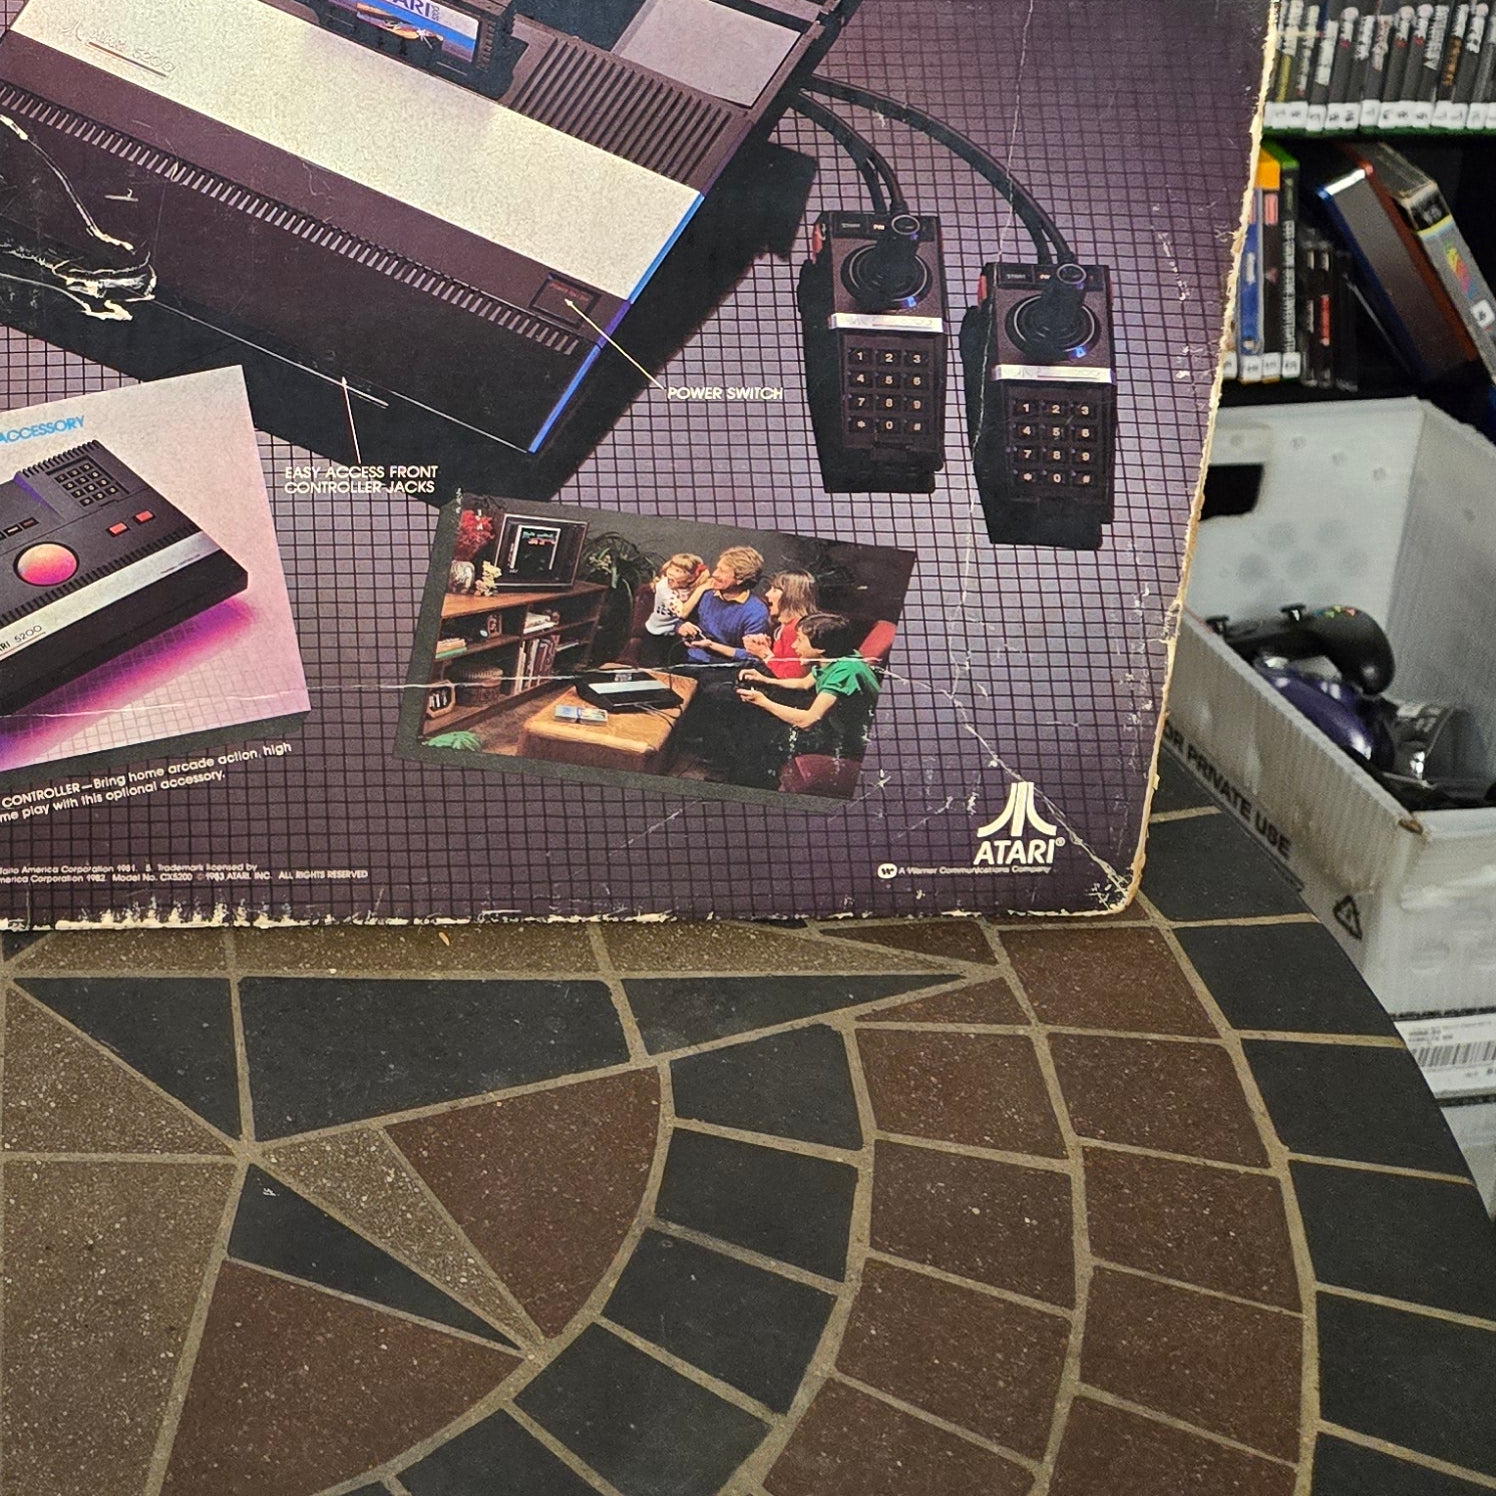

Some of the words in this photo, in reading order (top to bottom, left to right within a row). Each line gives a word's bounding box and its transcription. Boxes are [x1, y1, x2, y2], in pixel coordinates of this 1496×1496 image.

[667, 387, 722, 400] POWER
[727, 387, 783, 399] SWITCH
[285, 466, 319, 480] EASY
[325, 466, 385, 480] ACCESS
[389, 465, 438, 479] FRONT
[284, 481, 381, 494] CONTROLLER
[385, 480, 435, 494] JACKS
[14, 624, 43, 644] 5200
[1186, 749, 1252, 824] PRIVATE
[1254, 811, 1292, 859] USE
[973, 839, 1055, 865] ATARI
[279, 871, 294, 880] ALL
[295, 871, 325, 879] RIGHTS
[327, 870, 368, 879] RESERVED
